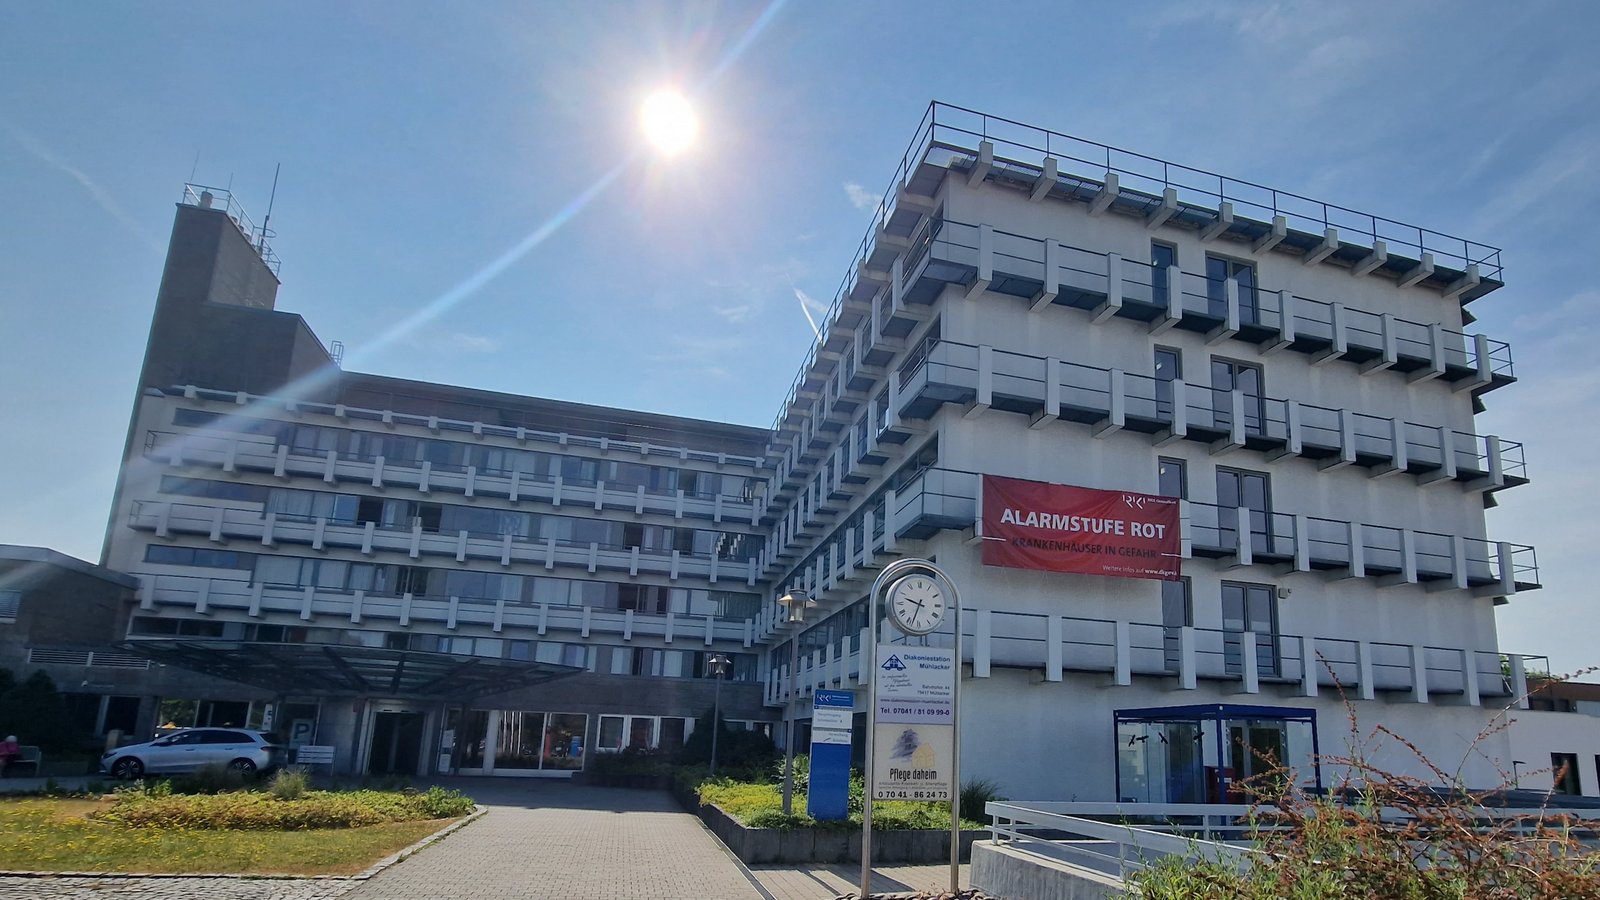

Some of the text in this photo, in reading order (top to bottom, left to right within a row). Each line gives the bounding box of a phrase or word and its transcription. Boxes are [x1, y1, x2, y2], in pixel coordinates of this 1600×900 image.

[1000, 508, 1166, 540] ALARMSTUFE ROT
[1012, 537, 1158, 559] KRANKENHÄUSER IN GEFAHR
[903, 654, 951, 662] Diakoniestation
[294, 723, 310, 740] P
[889, 768, 937, 781] Pflege daheim
[886, 791, 896, 799] 70
